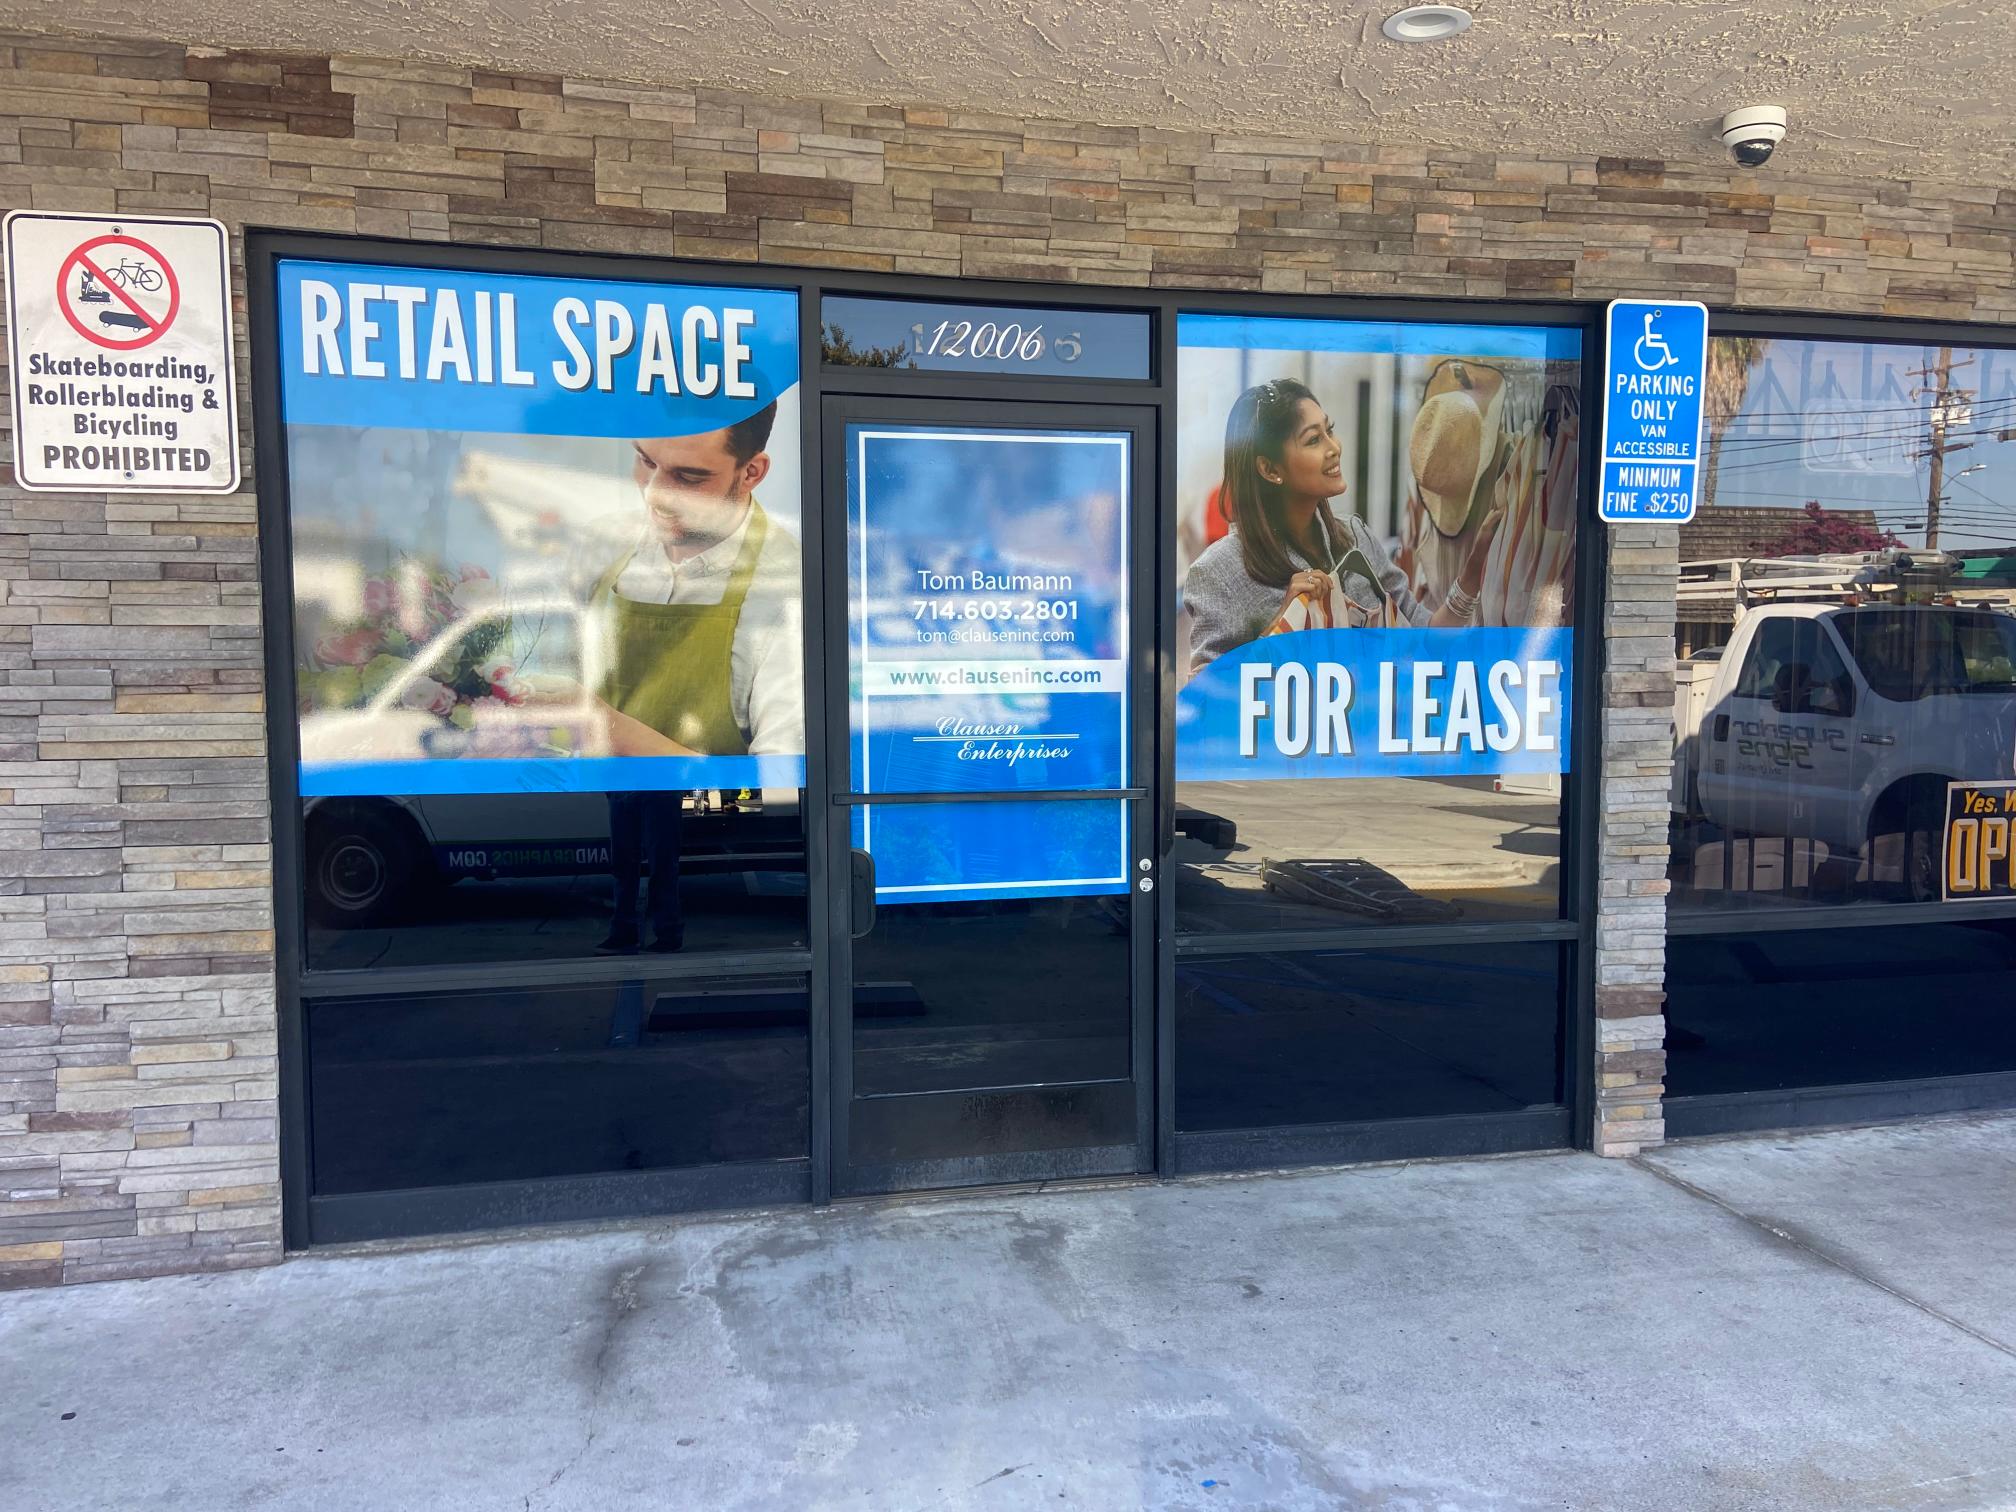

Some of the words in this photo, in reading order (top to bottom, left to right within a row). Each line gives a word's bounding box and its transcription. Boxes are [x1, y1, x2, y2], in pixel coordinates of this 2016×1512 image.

[300, 279, 537, 386] RETAIL
[552, 296, 757, 398] SPACE
[927, 320, 1043, 361] 12006
[29, 353, 215, 384] Skateboarding,
[1616, 374, 1694, 396] PARKING
[28, 383, 194, 413] Rollerblading
[202, 389, 219, 409] &
[1631, 399, 1677, 421] ONLY
[73, 412, 178, 440] Bicycling
[1640, 424, 1667, 438] VAN
[43, 445, 211, 472] PROHIBITED
[1614, 442, 1690, 456] ACCESSIBLE
[1618, 466, 1681, 488] MINIMUM
[1606, 492, 1638, 513] FINE
[1650, 492, 1689, 514] $250
[918, 570, 964, 591] Tom
[972, 570, 1073, 591] Baumann
[913, 600, 1078, 620] 714.603.2801
[917, 628, 1075, 644] tom@clauseninc.com
[890, 667, 1101, 685] www.clauseninc.com
[1240, 661, 1354, 757] FOR
[1378, 659, 1558, 754] LEASE
[935, 716, 1024, 737] Clausen
[957, 740, 1073, 767] Enterprises
